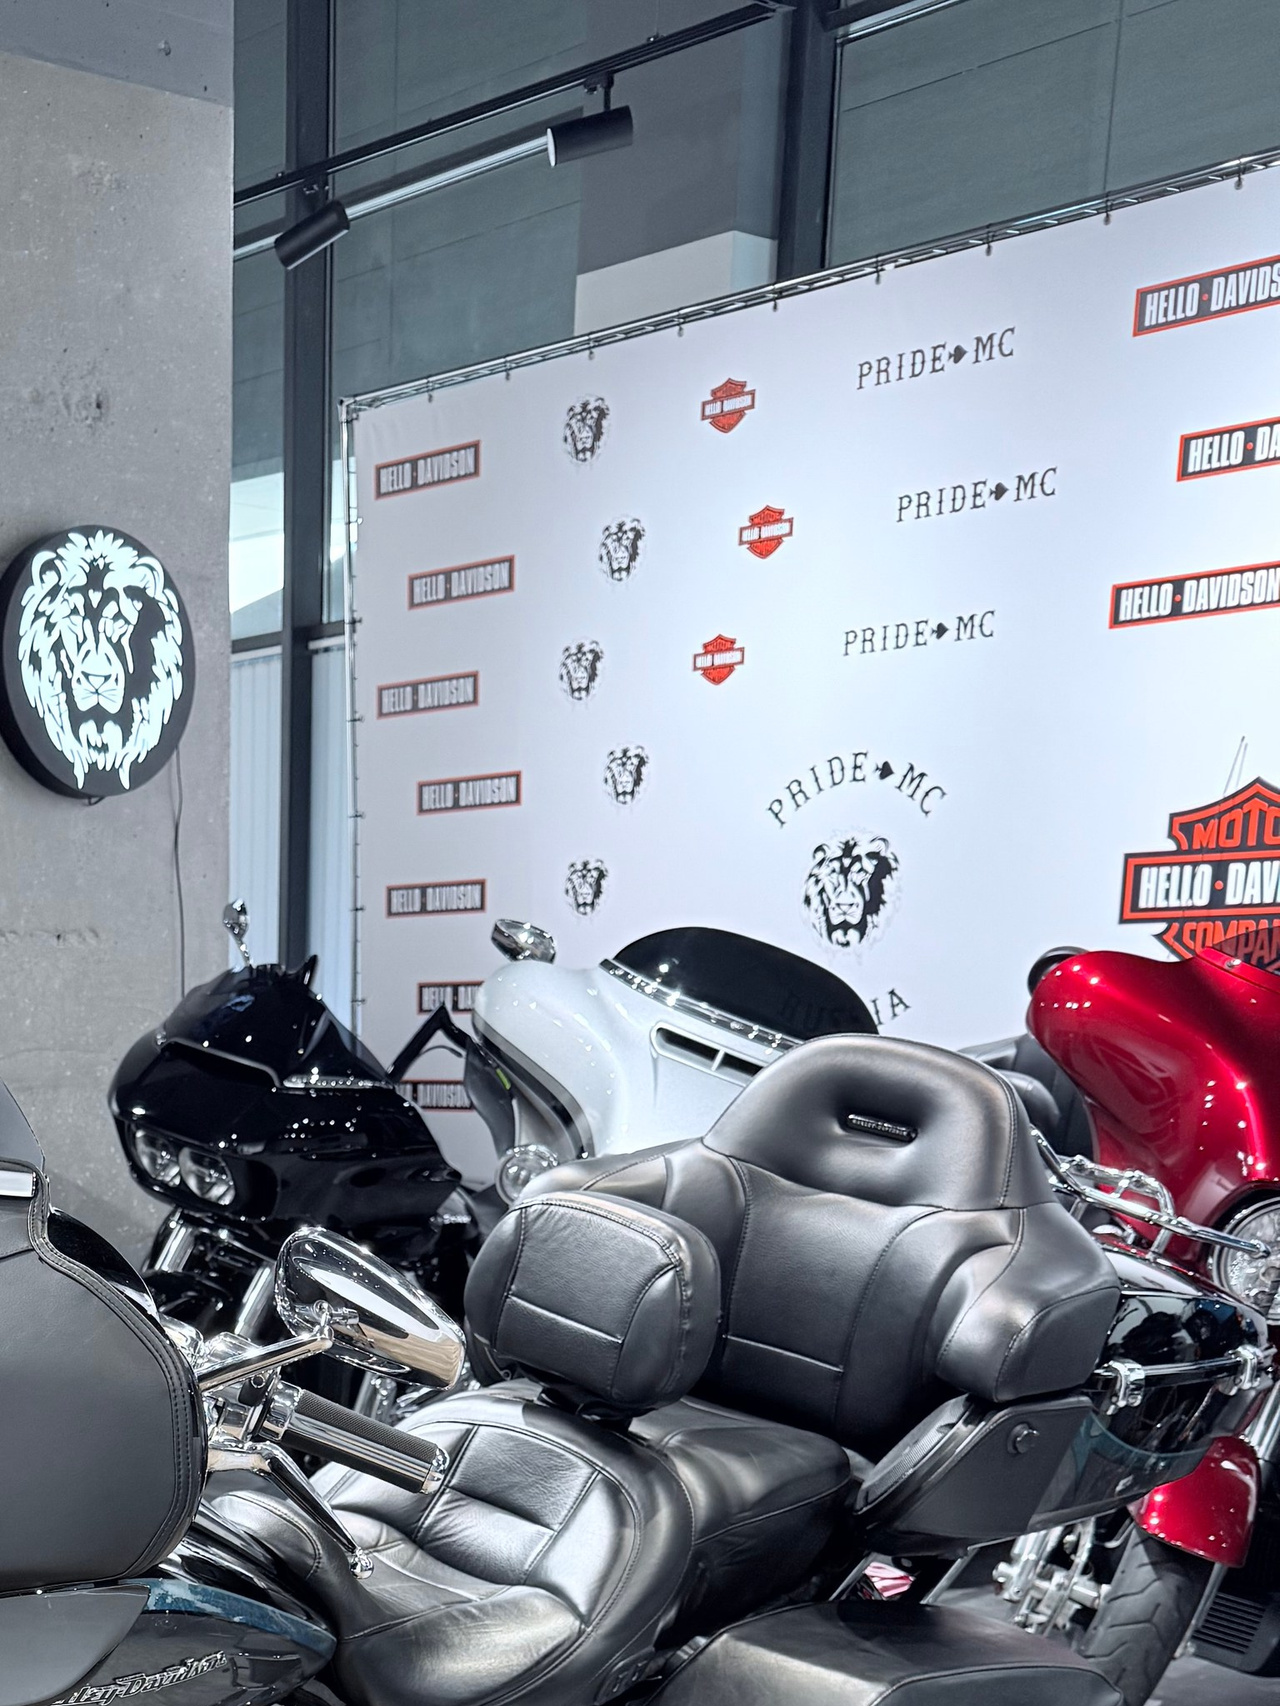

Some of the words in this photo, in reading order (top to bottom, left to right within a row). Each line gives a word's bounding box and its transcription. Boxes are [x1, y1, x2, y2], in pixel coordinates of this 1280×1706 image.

[1144, 282, 1200, 327] HELLO
[856, 341, 948, 390] PRIDE
[972, 327, 1016, 365] MC
[1187, 431, 1245, 474] HELLO
[896, 479, 988, 523] PRIDE
[1013, 467, 1058, 502] MC
[1119, 583, 1173, 622] HELLO
[1182, 567, 1280, 613] DAVIDSON
[842, 619, 929, 656] PRIDE
[954, 610, 996, 642] MC
[766, 750, 869, 829] PRIDE
[894, 762, 948, 818] MC
[1192, 797, 1280, 850] MOTO
[1138, 863, 1213, 908] HELLO
